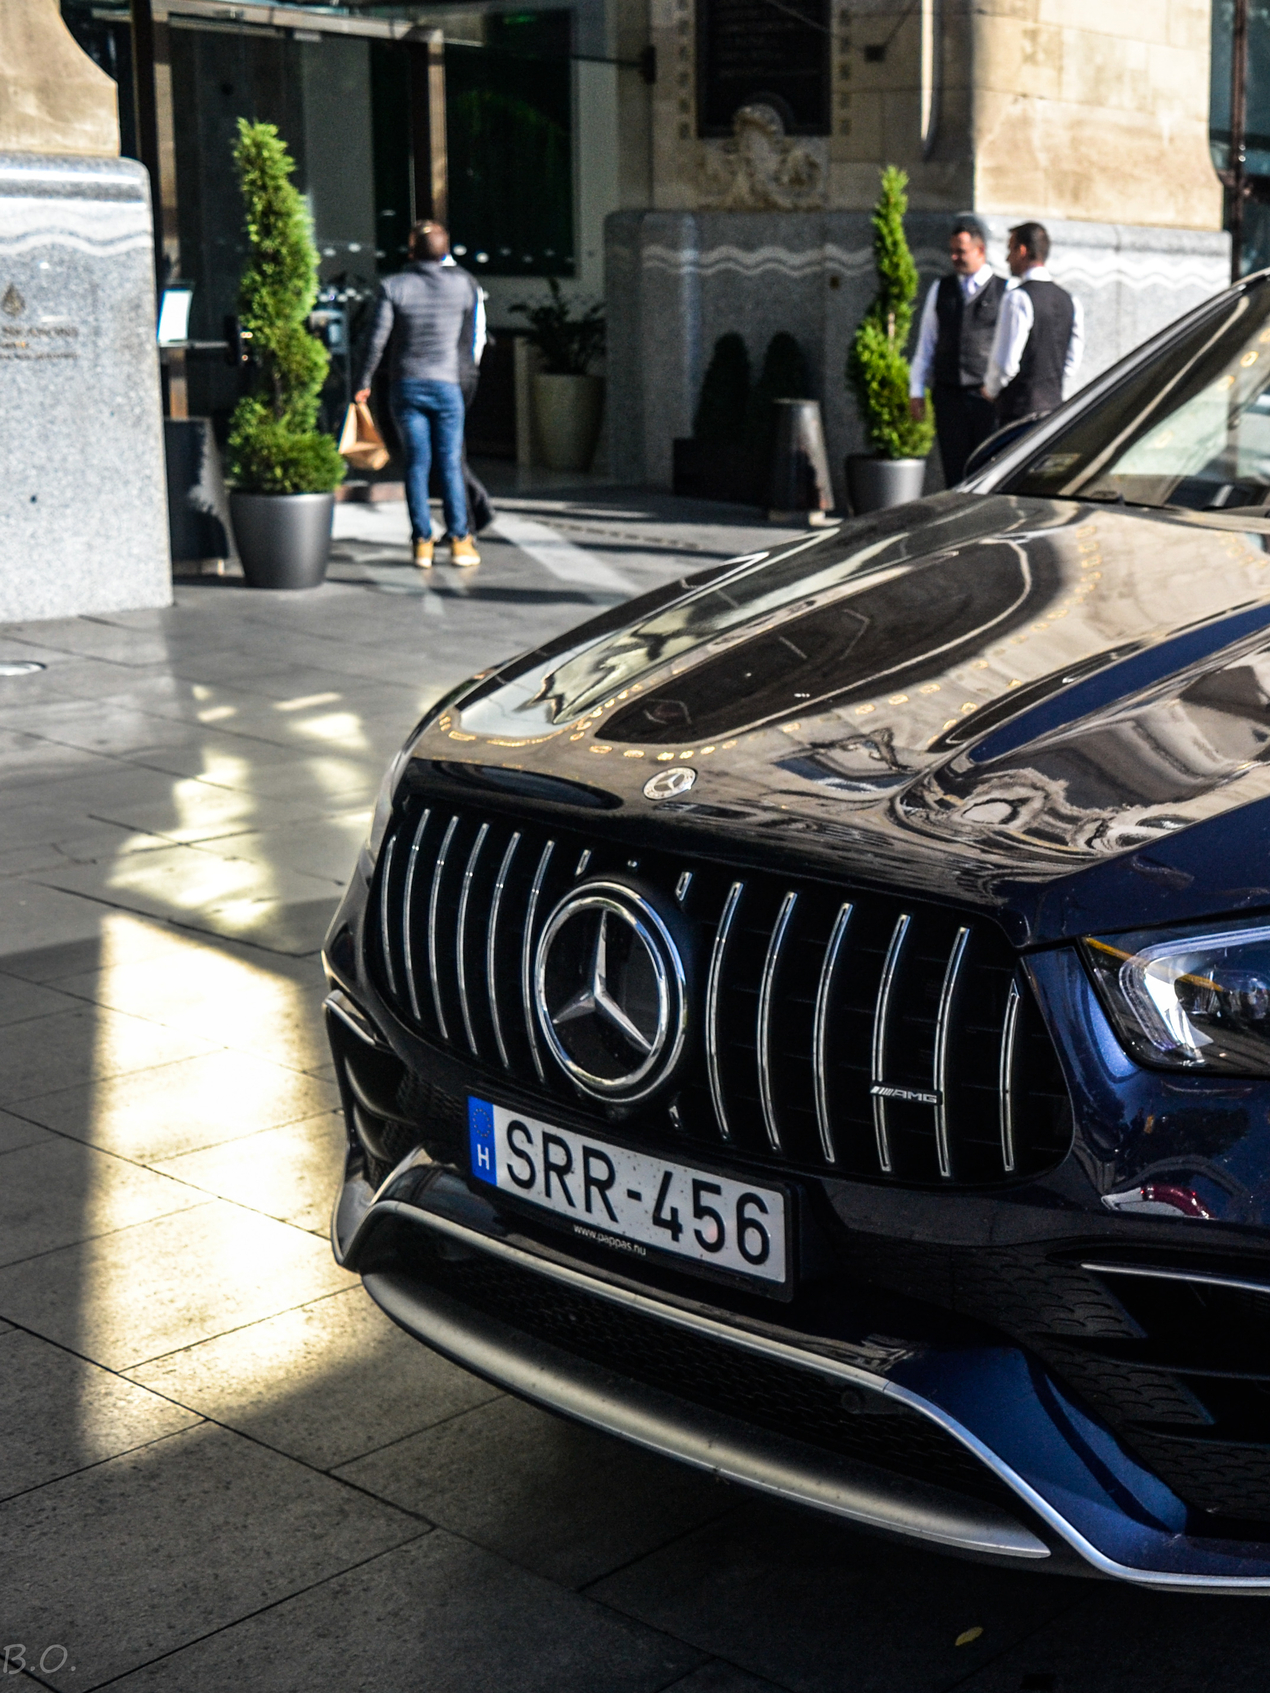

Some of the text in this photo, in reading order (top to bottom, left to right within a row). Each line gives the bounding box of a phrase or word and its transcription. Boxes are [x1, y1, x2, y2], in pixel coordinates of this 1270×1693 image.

[892, 1089, 937, 1104] AMG
[477, 1120, 770, 1266] H SRR-456
